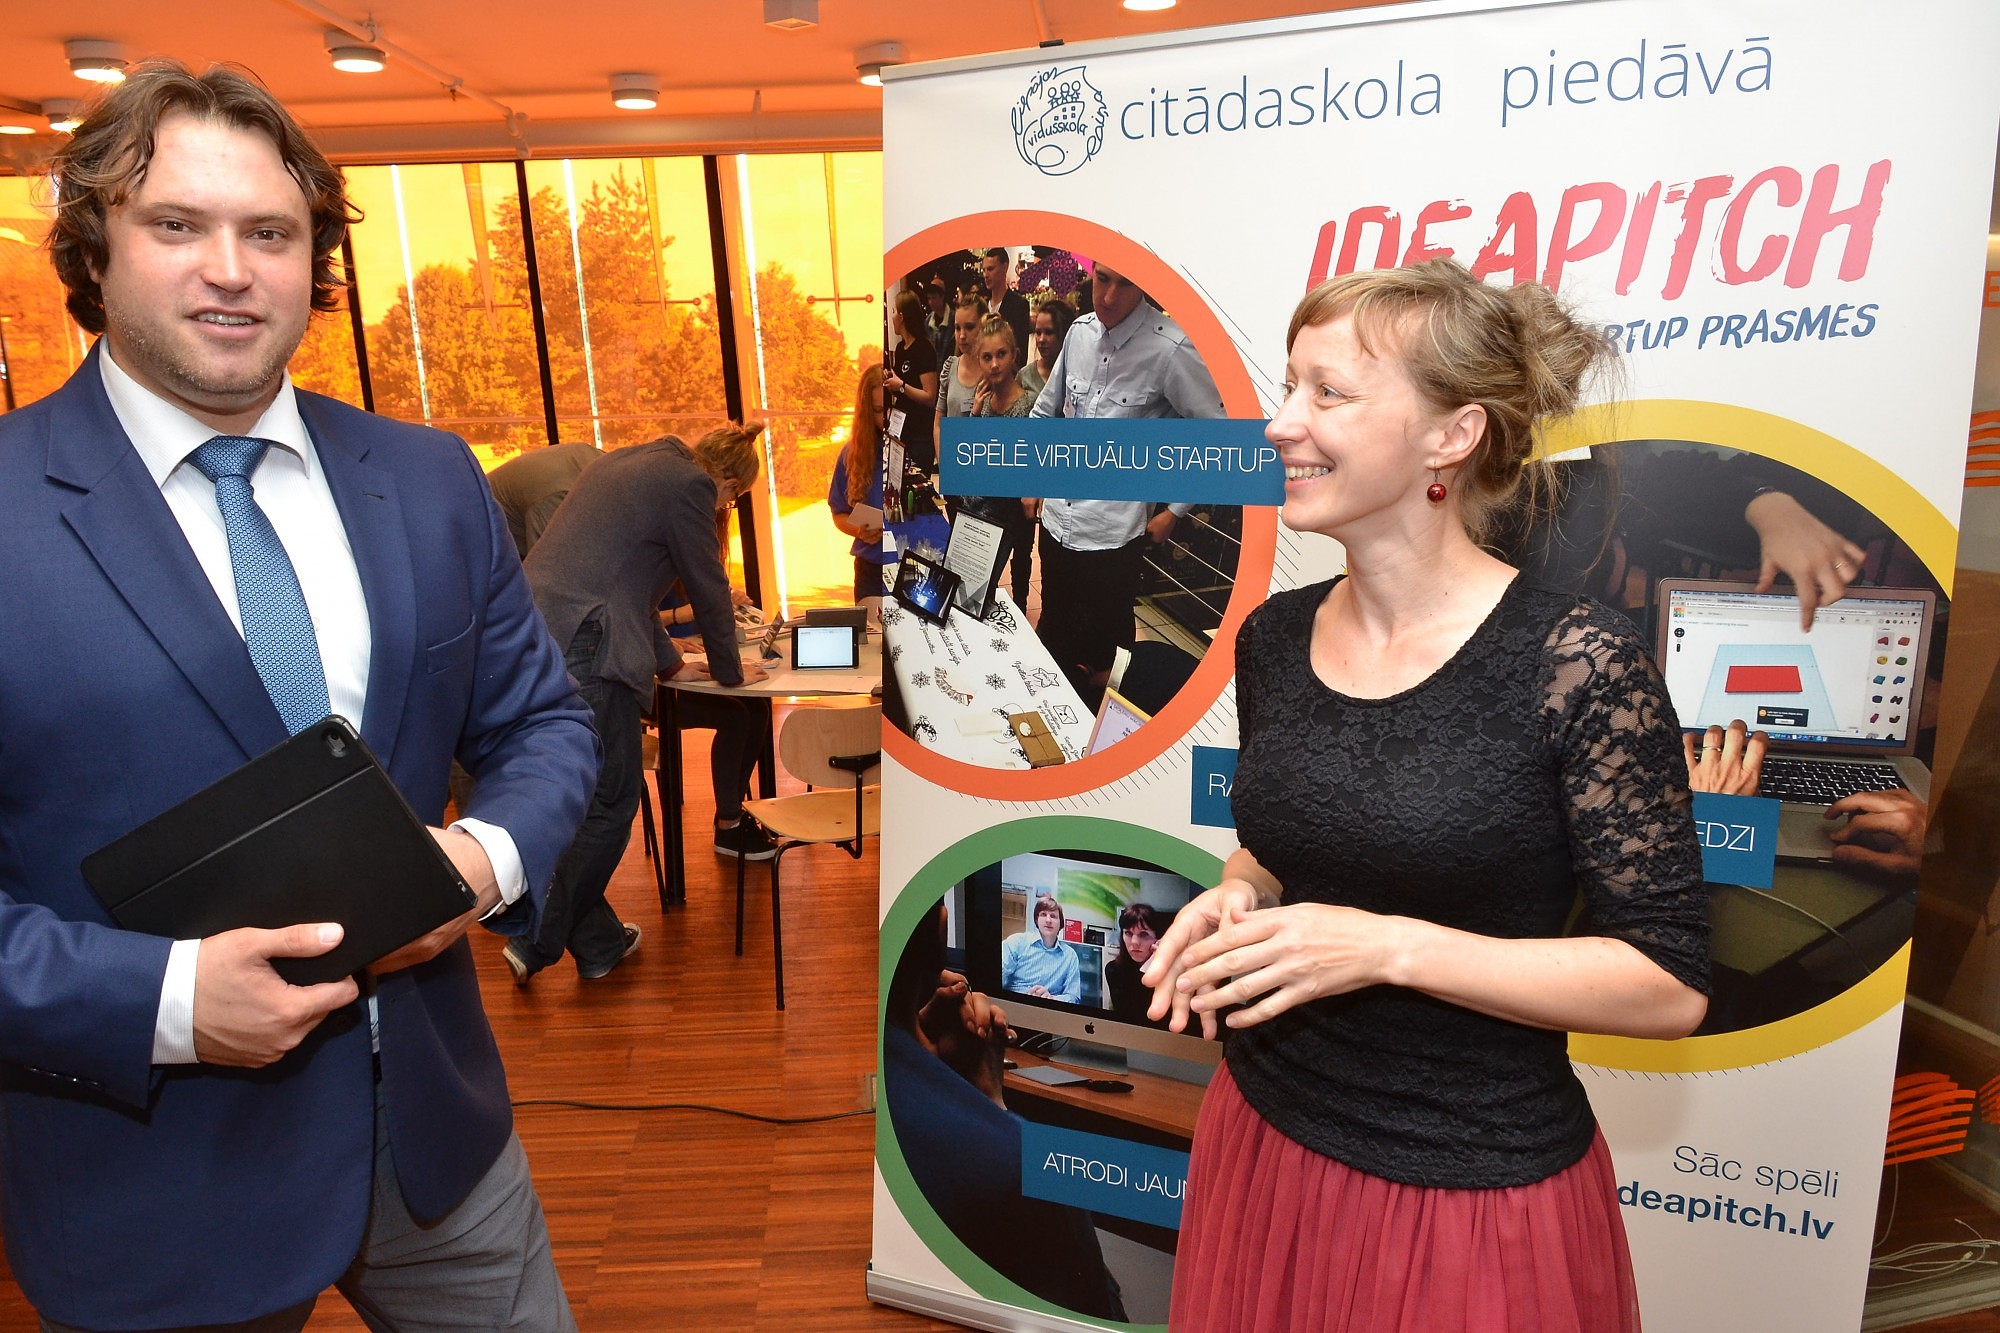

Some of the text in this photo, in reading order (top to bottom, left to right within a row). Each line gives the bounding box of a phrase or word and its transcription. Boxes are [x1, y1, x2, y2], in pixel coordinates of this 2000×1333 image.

[1120, 36, 1773, 140] citādaskola piedāvā
[1027, 121, 1088, 147] vidusskola
[1306, 158, 1892, 301] IDEAPITCH
[1697, 303, 1880, 350] PRASMES
[956, 438, 1277, 473] SPĒLĒ VIRTUĀLU STARTUP
[1043, 1152, 1128, 1188] ATRODI
[1673, 1145, 1839, 1199] Sāc spēli
